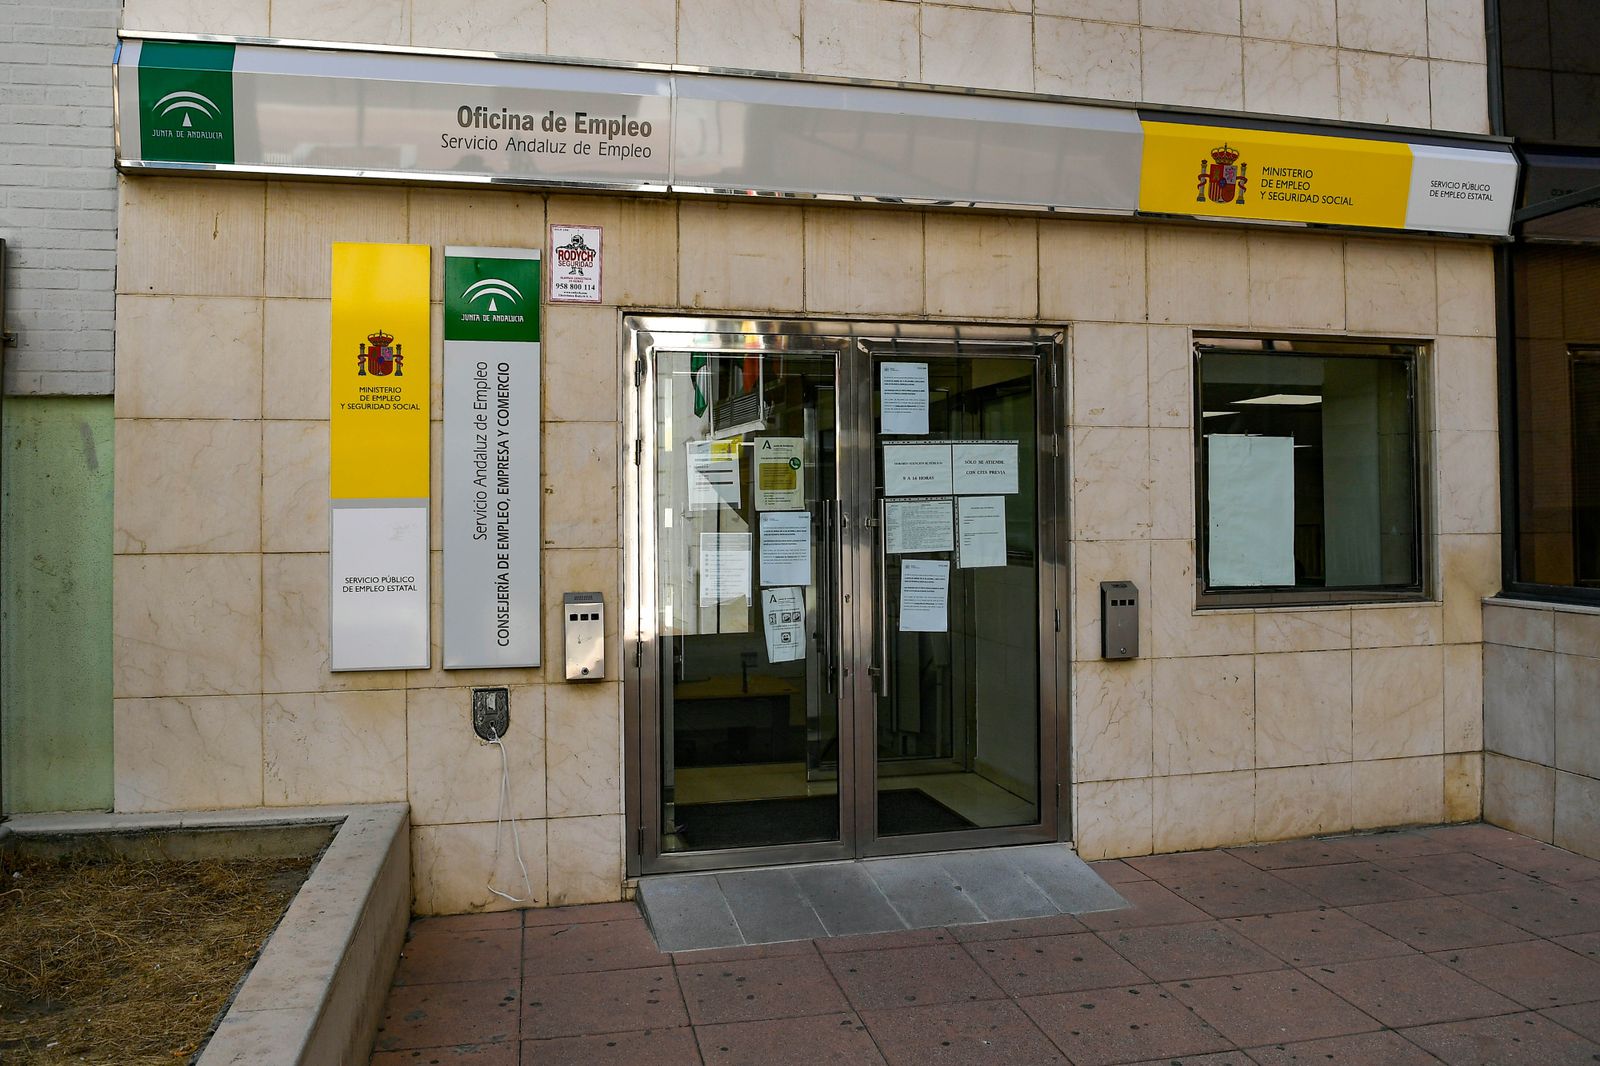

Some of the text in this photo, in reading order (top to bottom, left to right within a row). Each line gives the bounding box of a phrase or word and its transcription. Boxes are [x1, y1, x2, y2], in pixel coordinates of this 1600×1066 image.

[457, 105, 652, 140] Oficina de Empleo
[176, 130, 185, 138] DE
[441, 133, 652, 161] Servicio Andaluz de Empleo
[1262, 166, 1314, 179] MINISTERIO
[1261, 179, 1311, 191] DE EMPLEO
[1430, 180, 1491, 193] SERVICIO PÚBLICO
[1260, 191, 1354, 206] Y SEGURIDAD SOCIAL
[1429, 190, 1494, 202] DE EMPLEO ESTATAL
[557, 250, 593, 262] RODYCH
[556, 282, 568, 290] 958
[570, 283, 582, 291] 800
[461, 313, 481, 322] JUNTA
[482, 314, 491, 322] DE
[359, 386, 402, 394] MINISTERIO
[360, 394, 401, 402] DE EMPLEO
[340, 402, 421, 411] Y SEGURIDAD SOCIAL
[472, 361, 491, 541] Servicio Andaluz de Empleo
[494, 362, 512, 647] CONSEJERÍA DE EMPLEO, EMPRESA Y COMERCIO
[345, 574, 415, 584] SERVICIO PÚBLICO
[355, 585, 385, 593] EMPLEO
